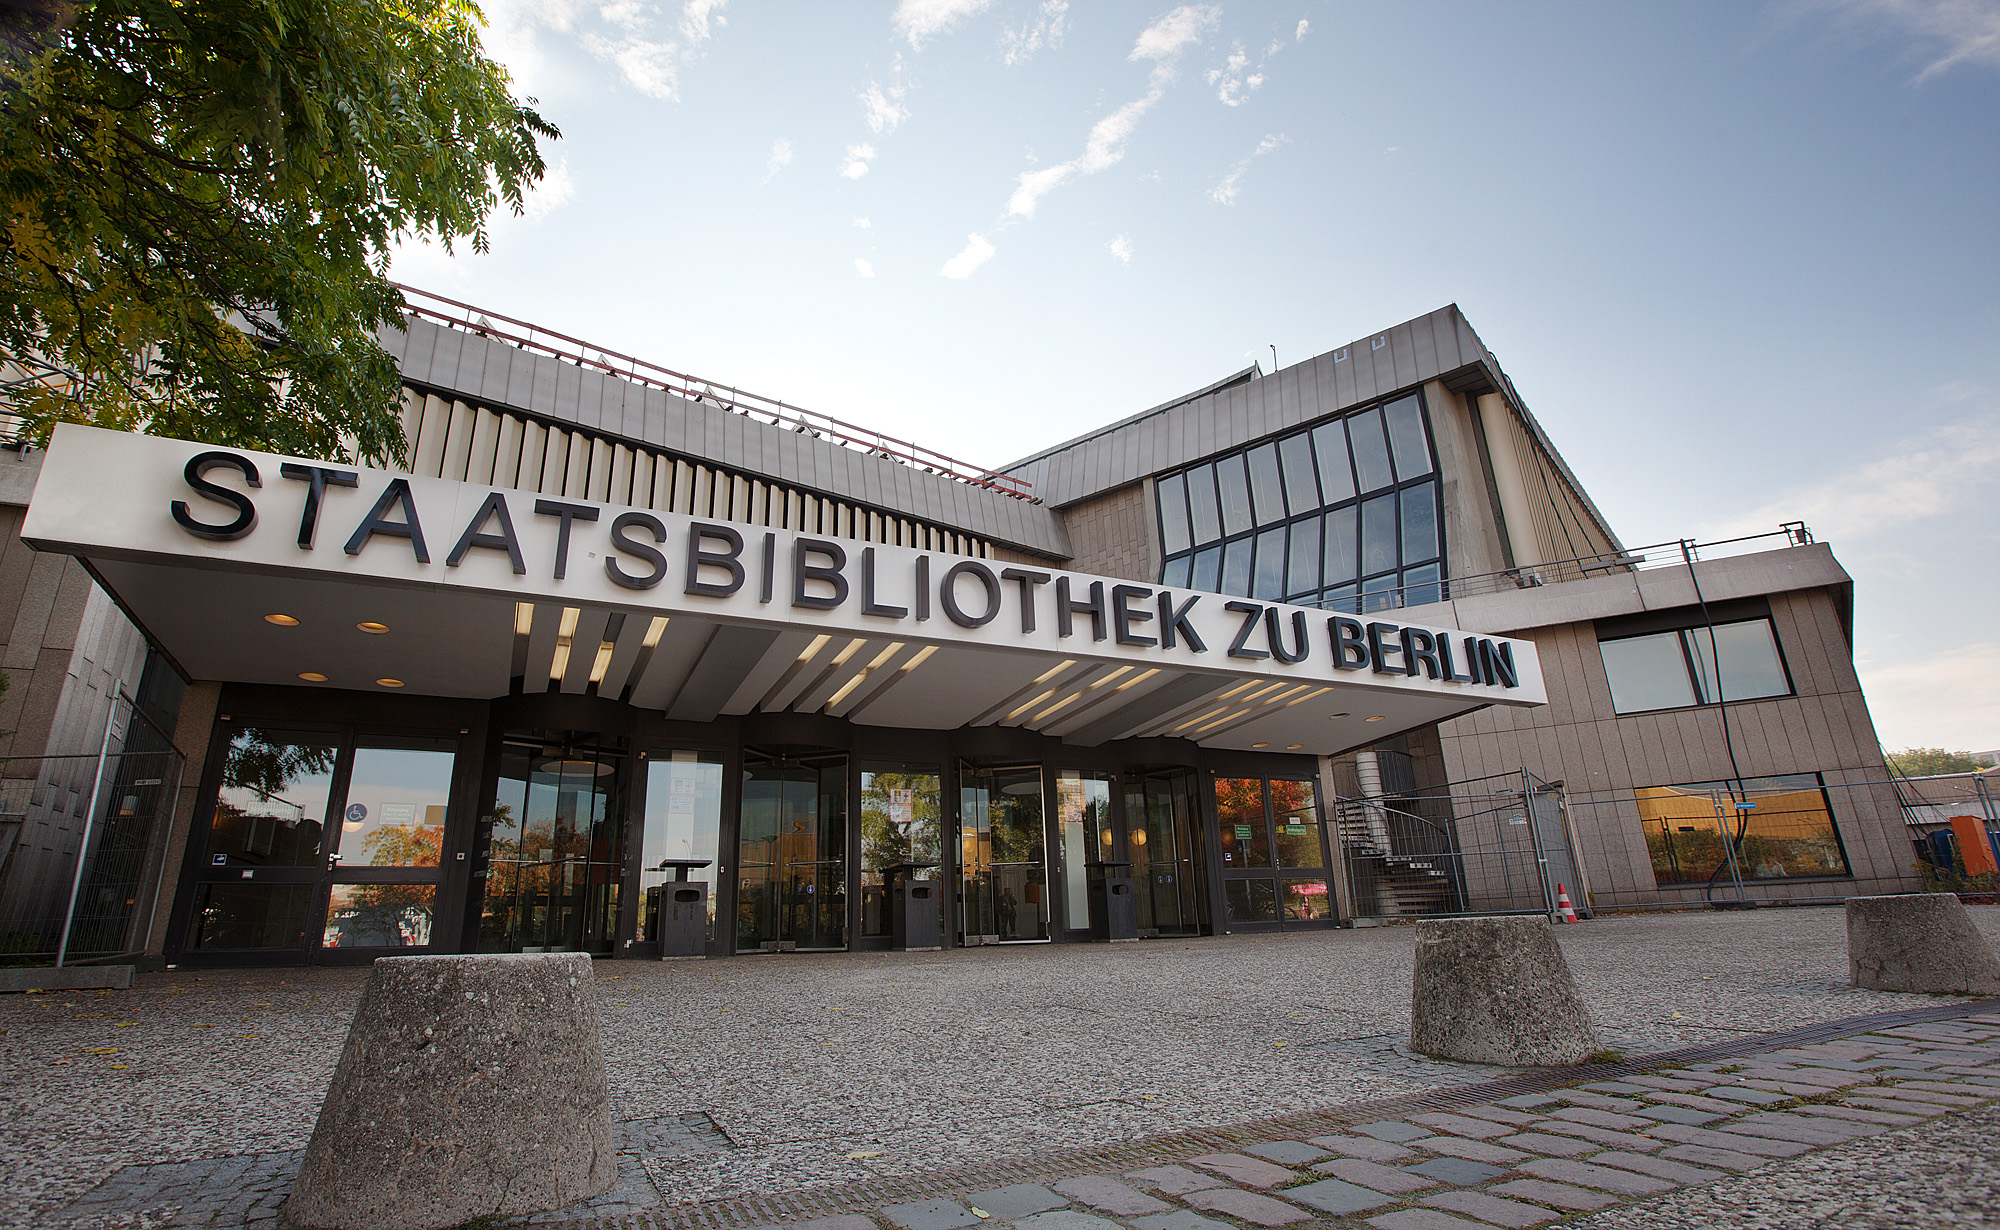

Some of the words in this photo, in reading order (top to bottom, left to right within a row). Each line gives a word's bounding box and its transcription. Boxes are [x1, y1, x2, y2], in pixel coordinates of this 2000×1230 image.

[170, 450, 1208, 656] STAATSBIBLIOTHEK
[1224, 600, 1309, 665] ZU
[1327, 615, 1519, 689] BERLIN
